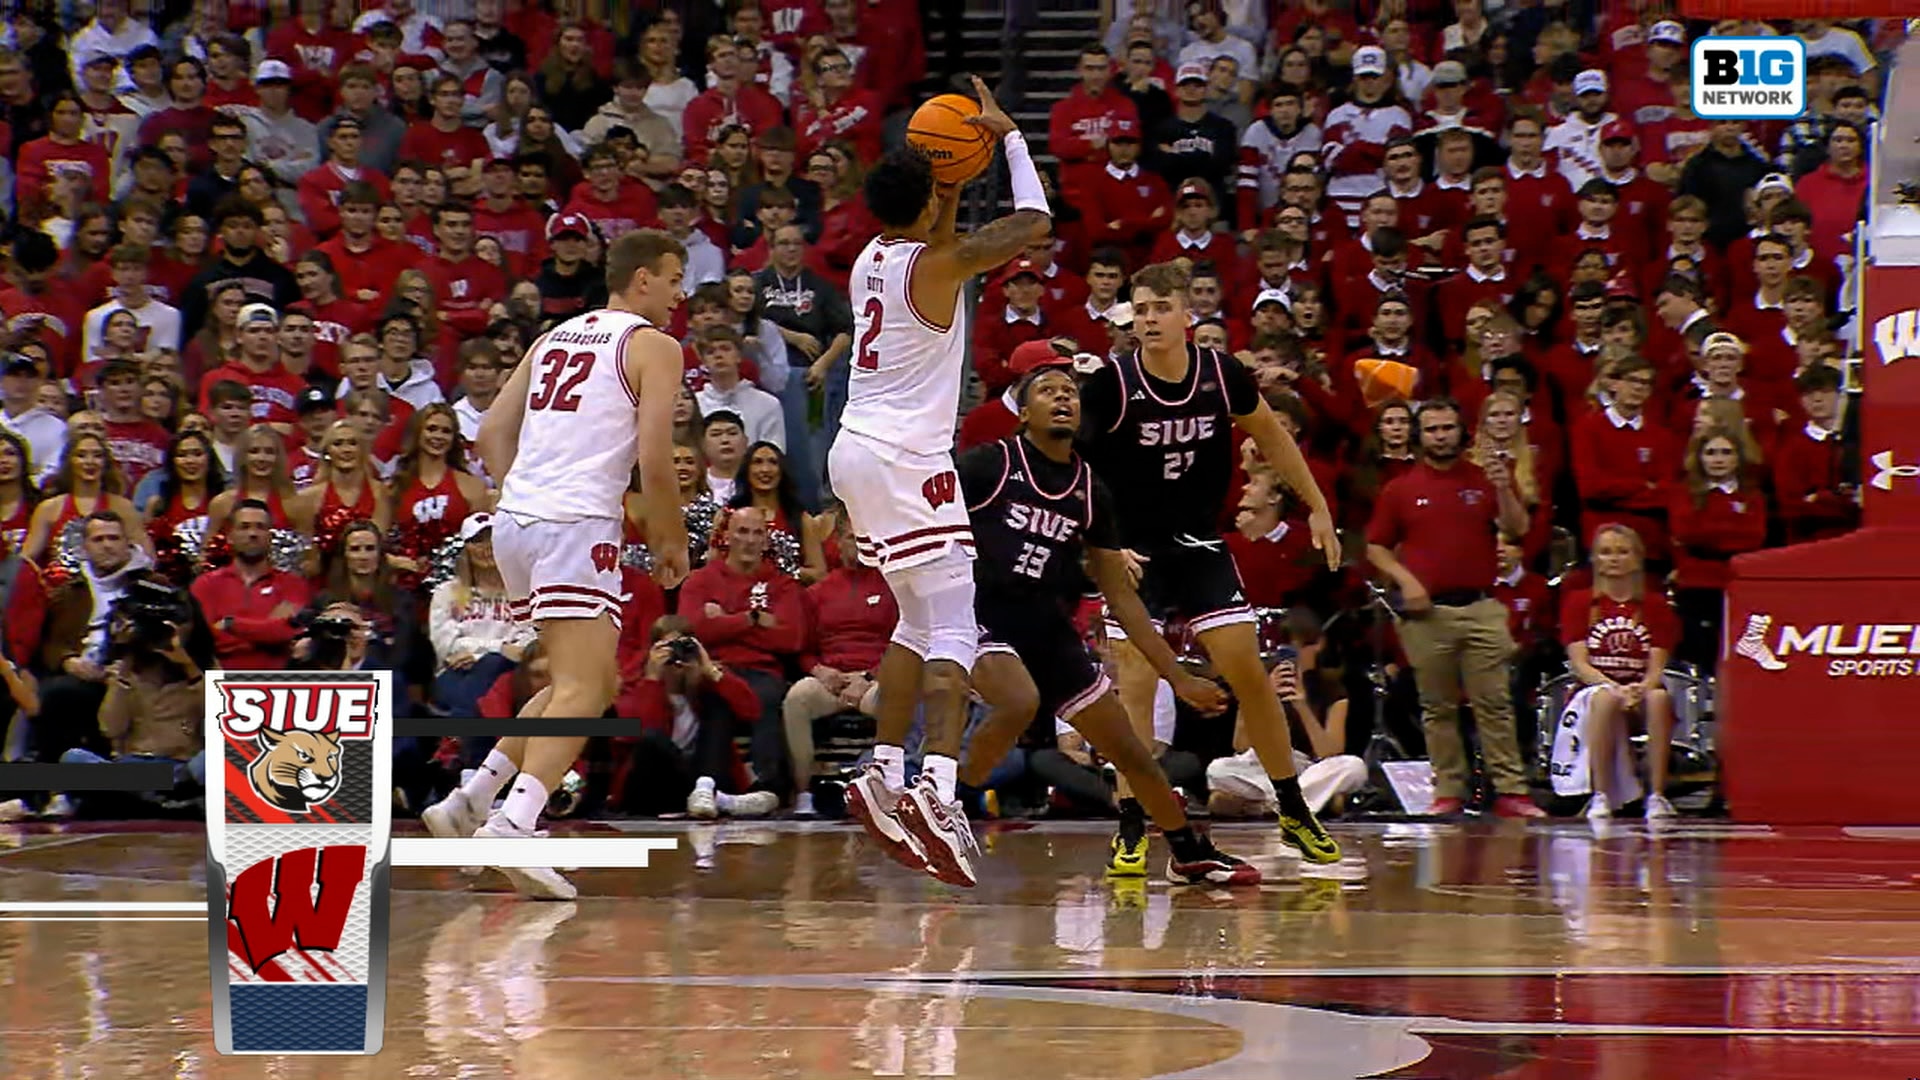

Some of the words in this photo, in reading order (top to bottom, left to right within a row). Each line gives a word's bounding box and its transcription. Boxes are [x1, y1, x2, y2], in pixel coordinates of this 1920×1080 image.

[857, 297, 883, 370] 2
[529, 348, 596, 412] 32
[1138, 415, 1216, 446] SIUE
[922, 470, 956, 512] W
[1006, 502, 1079, 542] SIUE
[590, 542, 619, 574] W
[1012, 541, 1051, 579] 33
[1828, 659, 1914, 677] SPORTS
